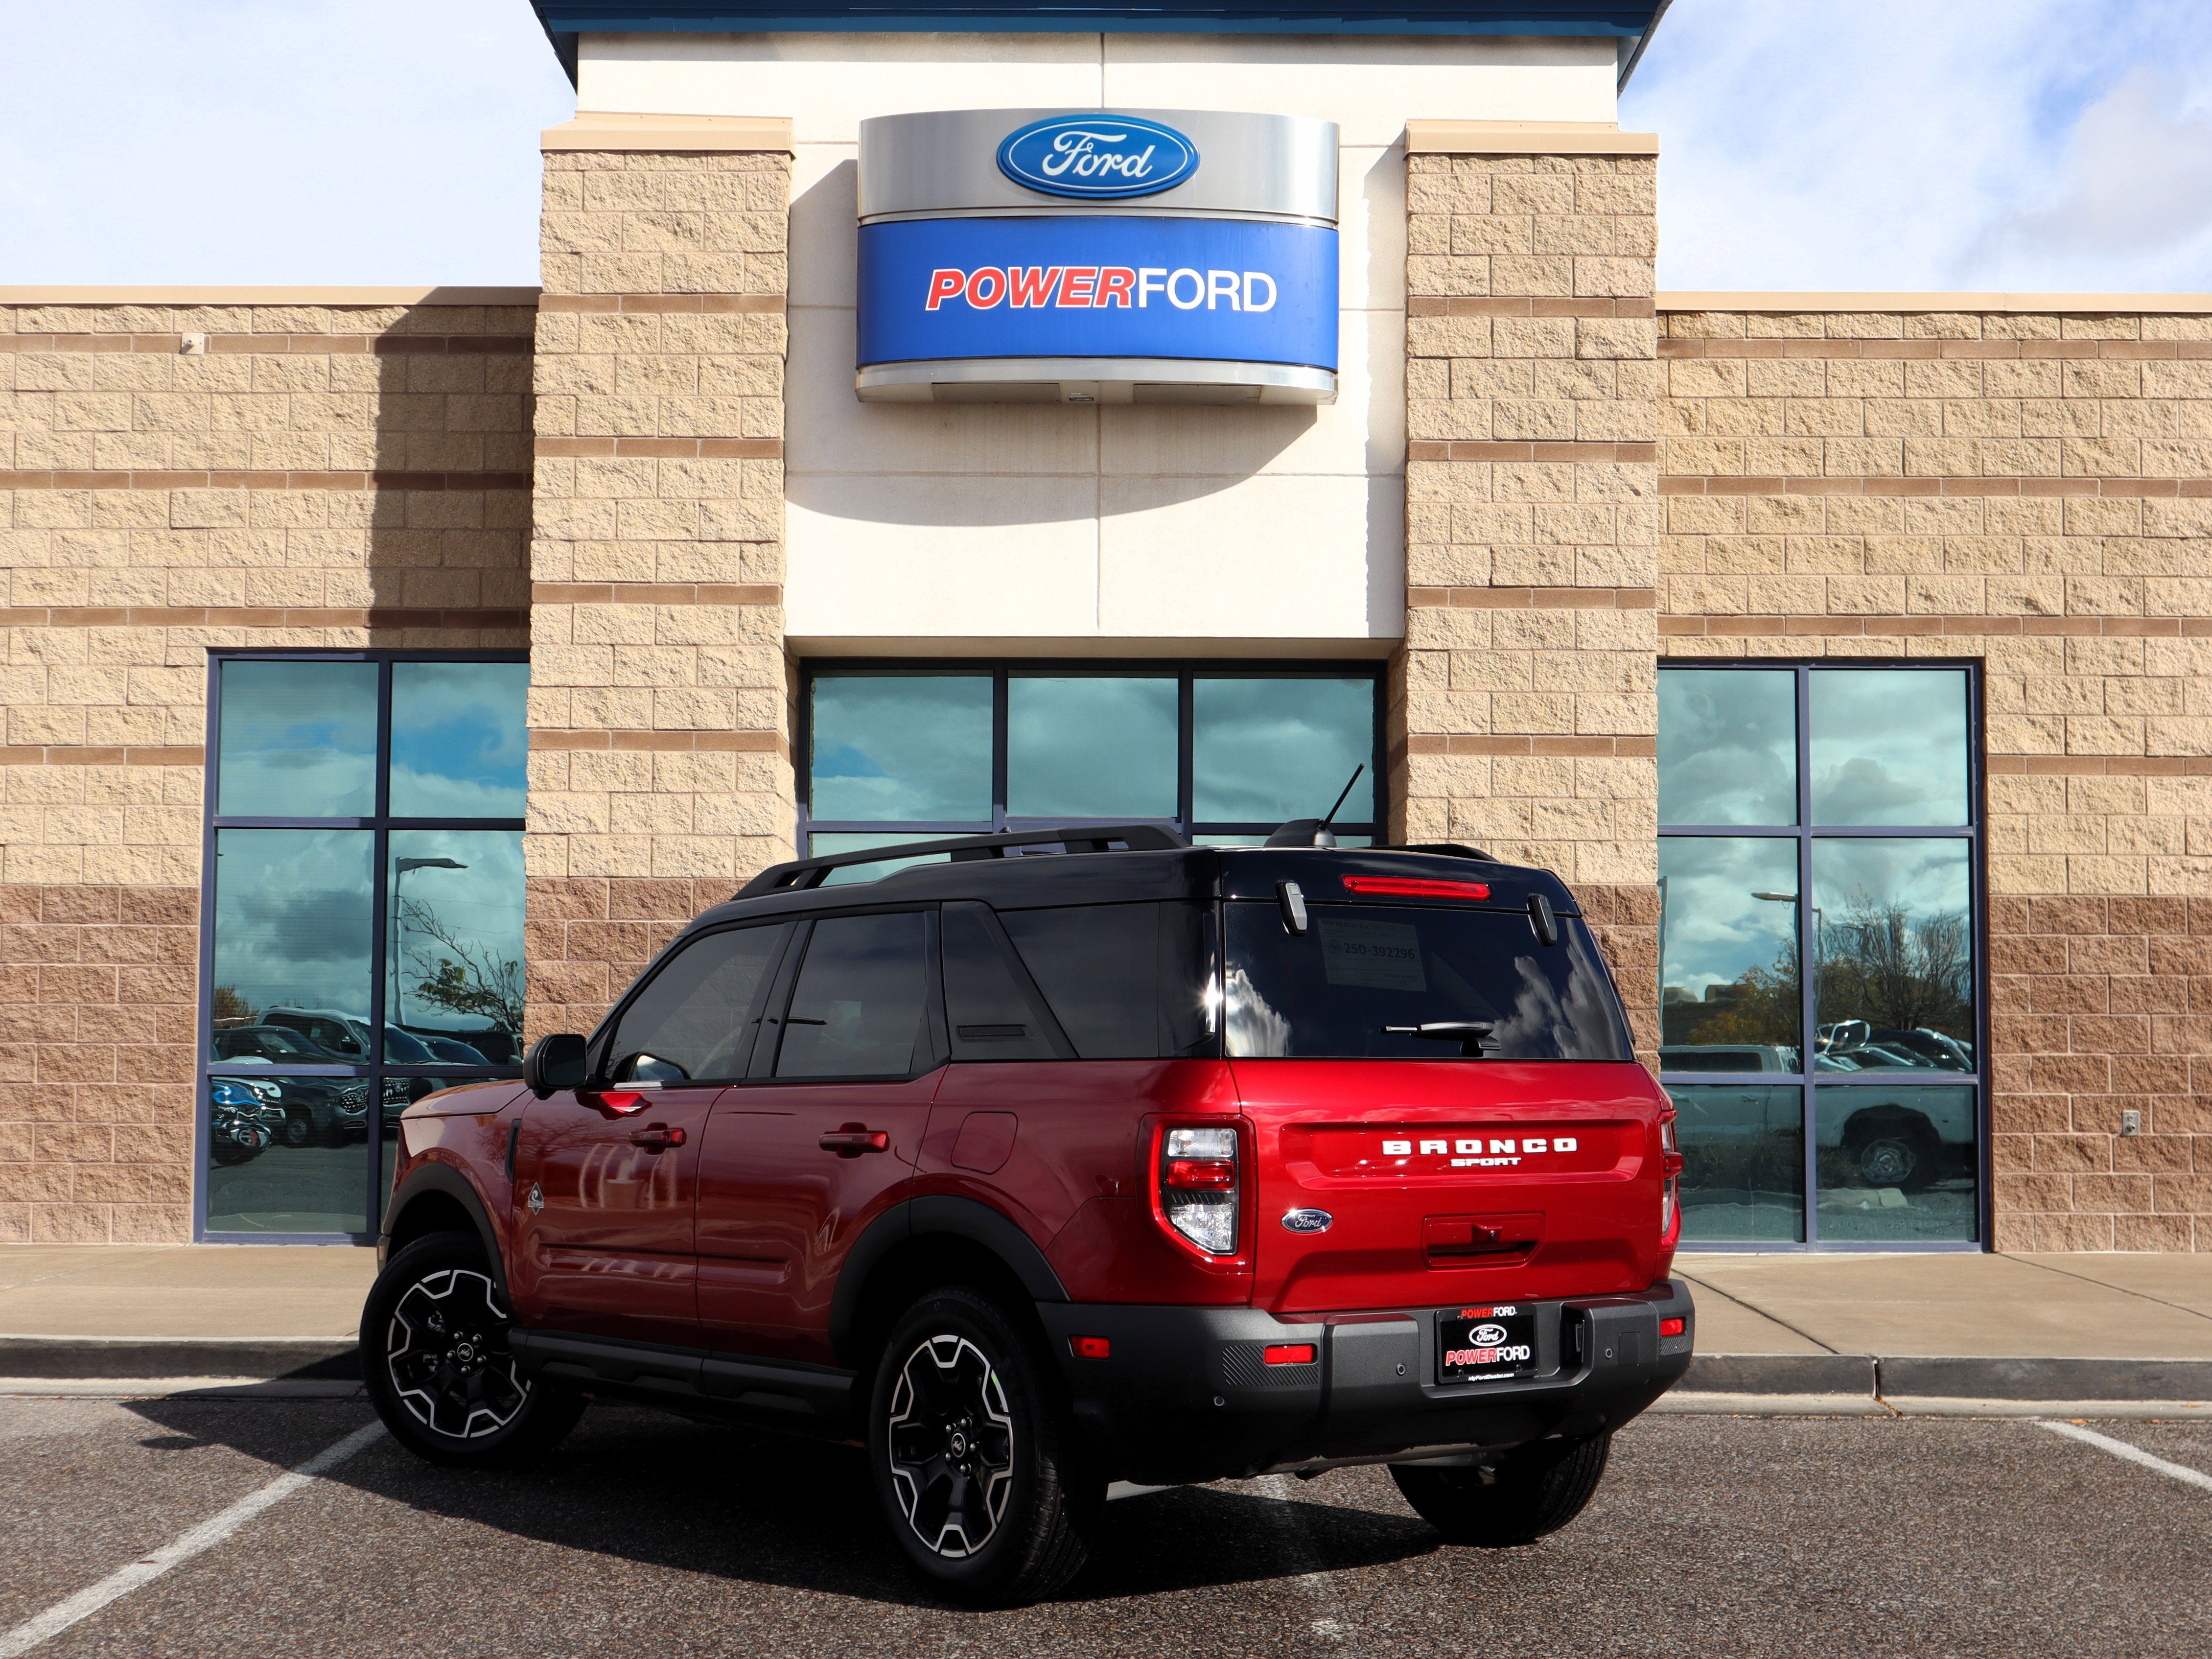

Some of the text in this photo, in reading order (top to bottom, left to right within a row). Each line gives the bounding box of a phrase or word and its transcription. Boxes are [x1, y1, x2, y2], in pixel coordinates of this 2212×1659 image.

[1042, 132, 1155, 178] Ford
[925, 266, 1277, 312] POWERFORD
[1344, 943, 1416, 959] 25D-392296
[1382, 1138, 1577, 1155] BRONCO
[1450, 1157, 1521, 1167] SPORT
[1295, 1214, 1322, 1228] Ford
[1477, 1328, 1499, 1341] Ford
[1445, 1345, 1530, 1366] POWERFORD
[1468, 1373, 1514, 1381] MyFordDealer.com
